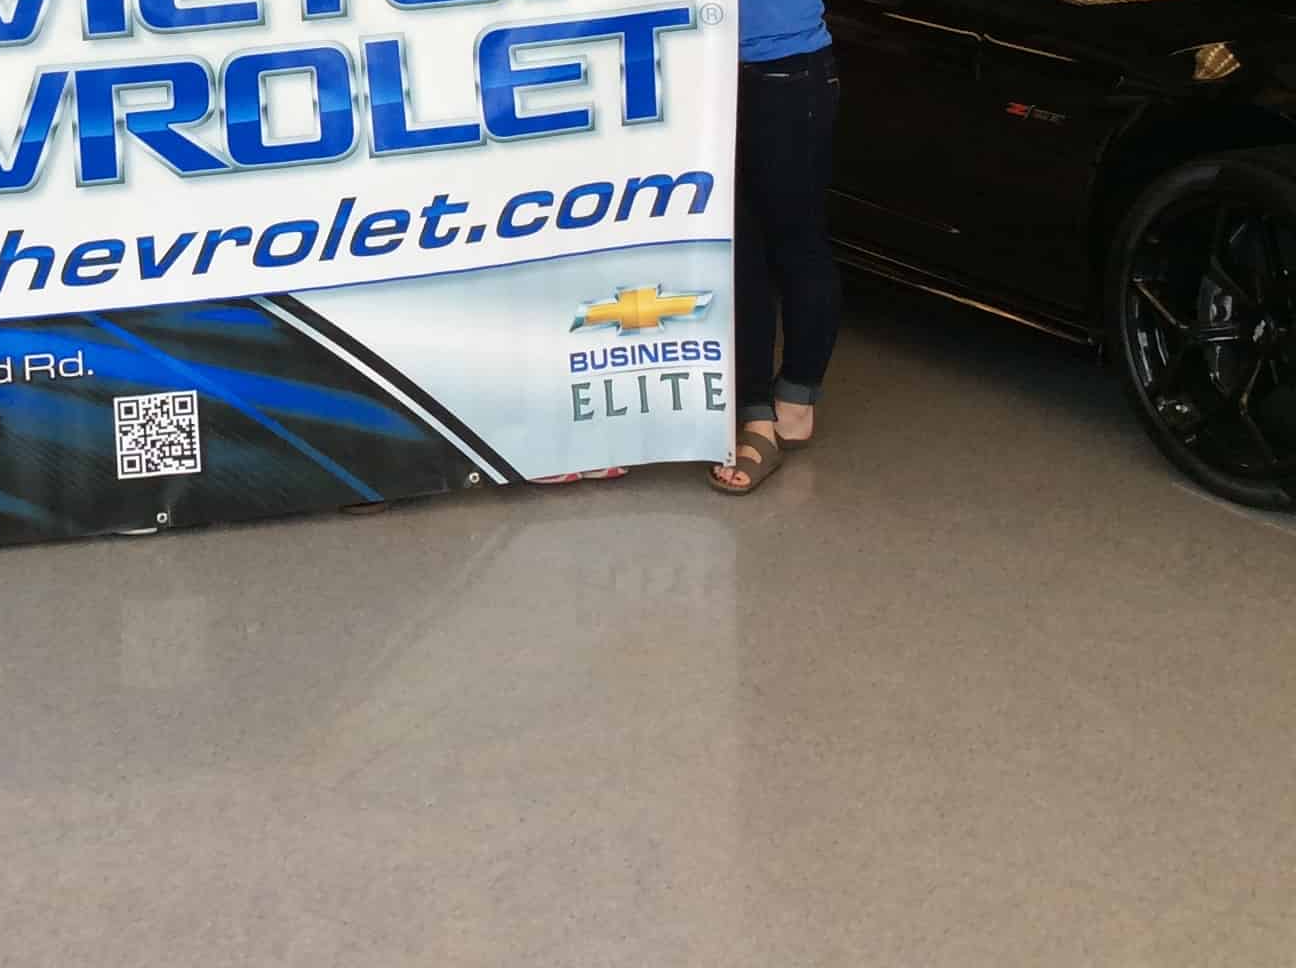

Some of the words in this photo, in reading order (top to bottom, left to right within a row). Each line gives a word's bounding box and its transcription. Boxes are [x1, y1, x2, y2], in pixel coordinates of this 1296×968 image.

[24, 350, 95, 382] Rd.
[570, 339, 722, 373] BUSINESS
[571, 372, 726, 421] ELITE
